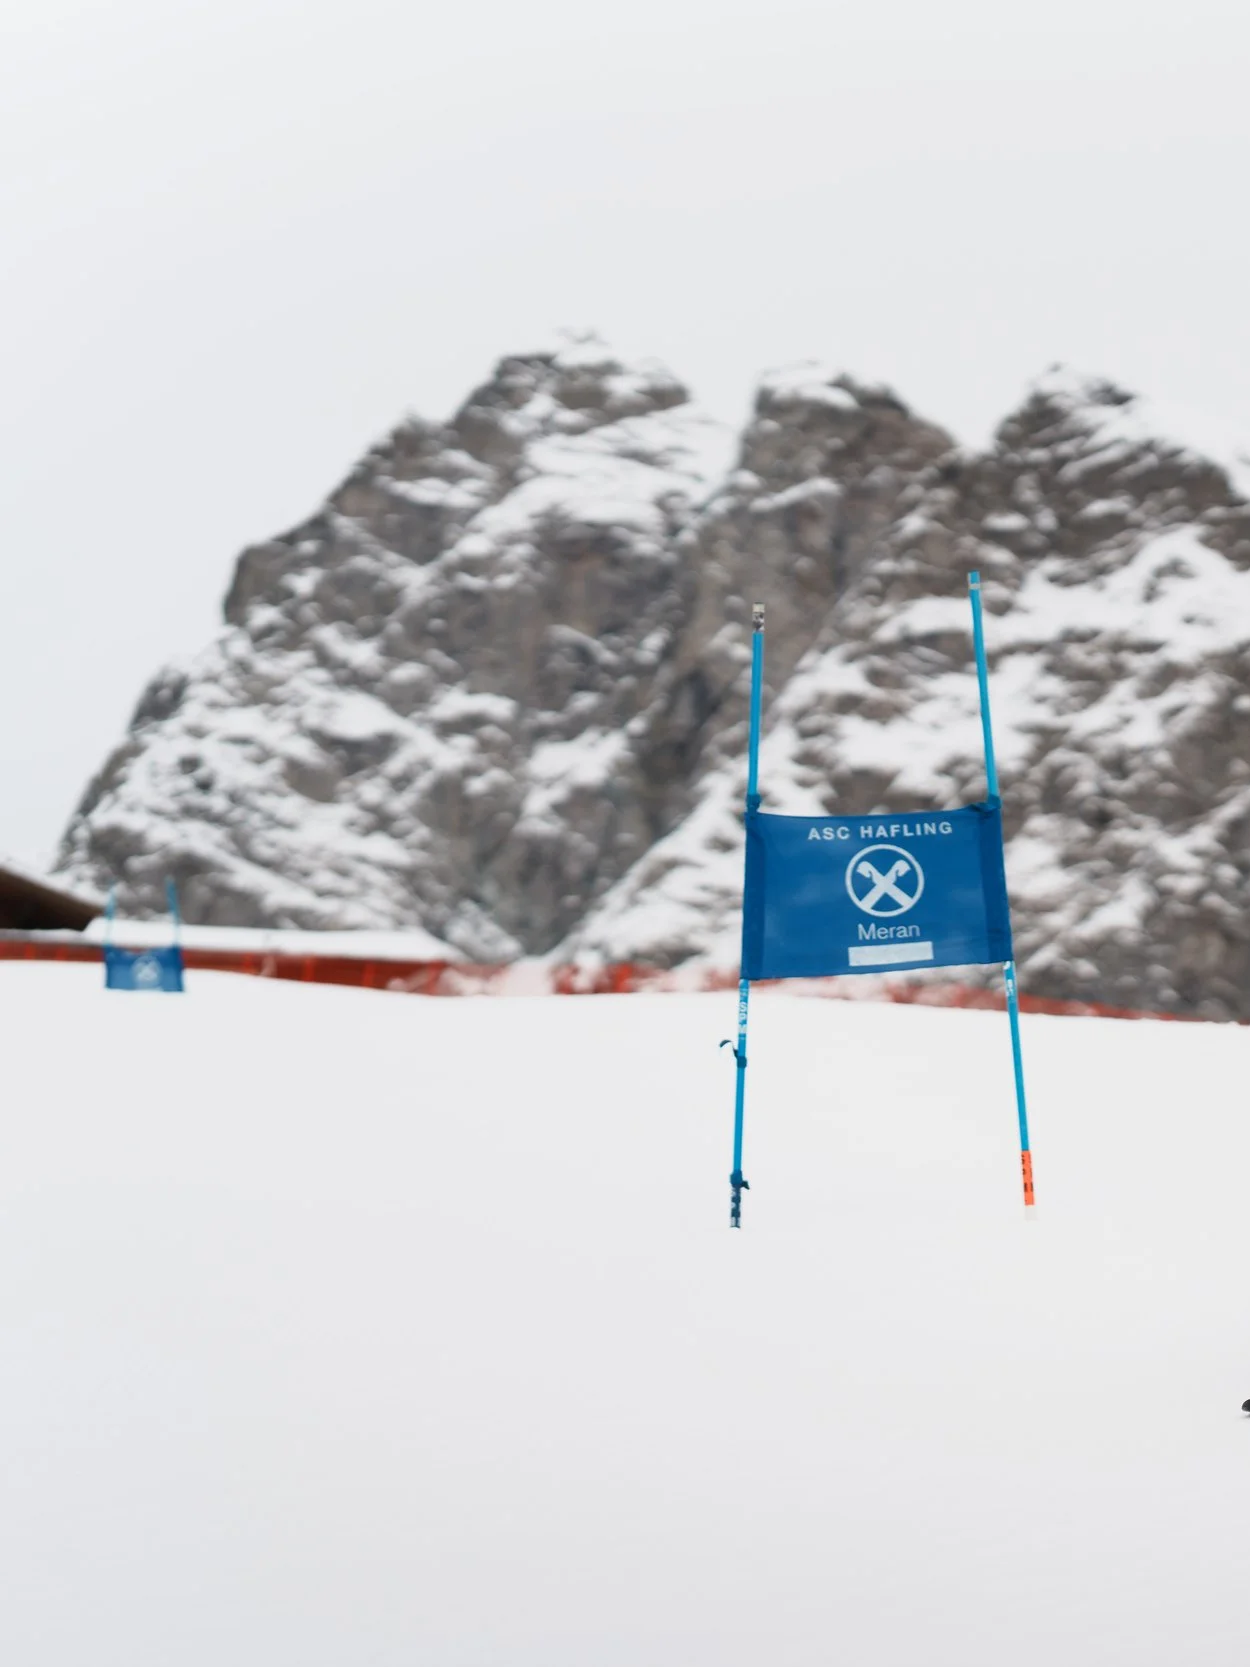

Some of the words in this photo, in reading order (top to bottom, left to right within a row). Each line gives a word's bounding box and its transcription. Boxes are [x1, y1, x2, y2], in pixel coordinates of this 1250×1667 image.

[808, 826, 850, 841] ASC
[860, 821, 953, 839] HAFLING
[858, 922, 921, 941] Meran
